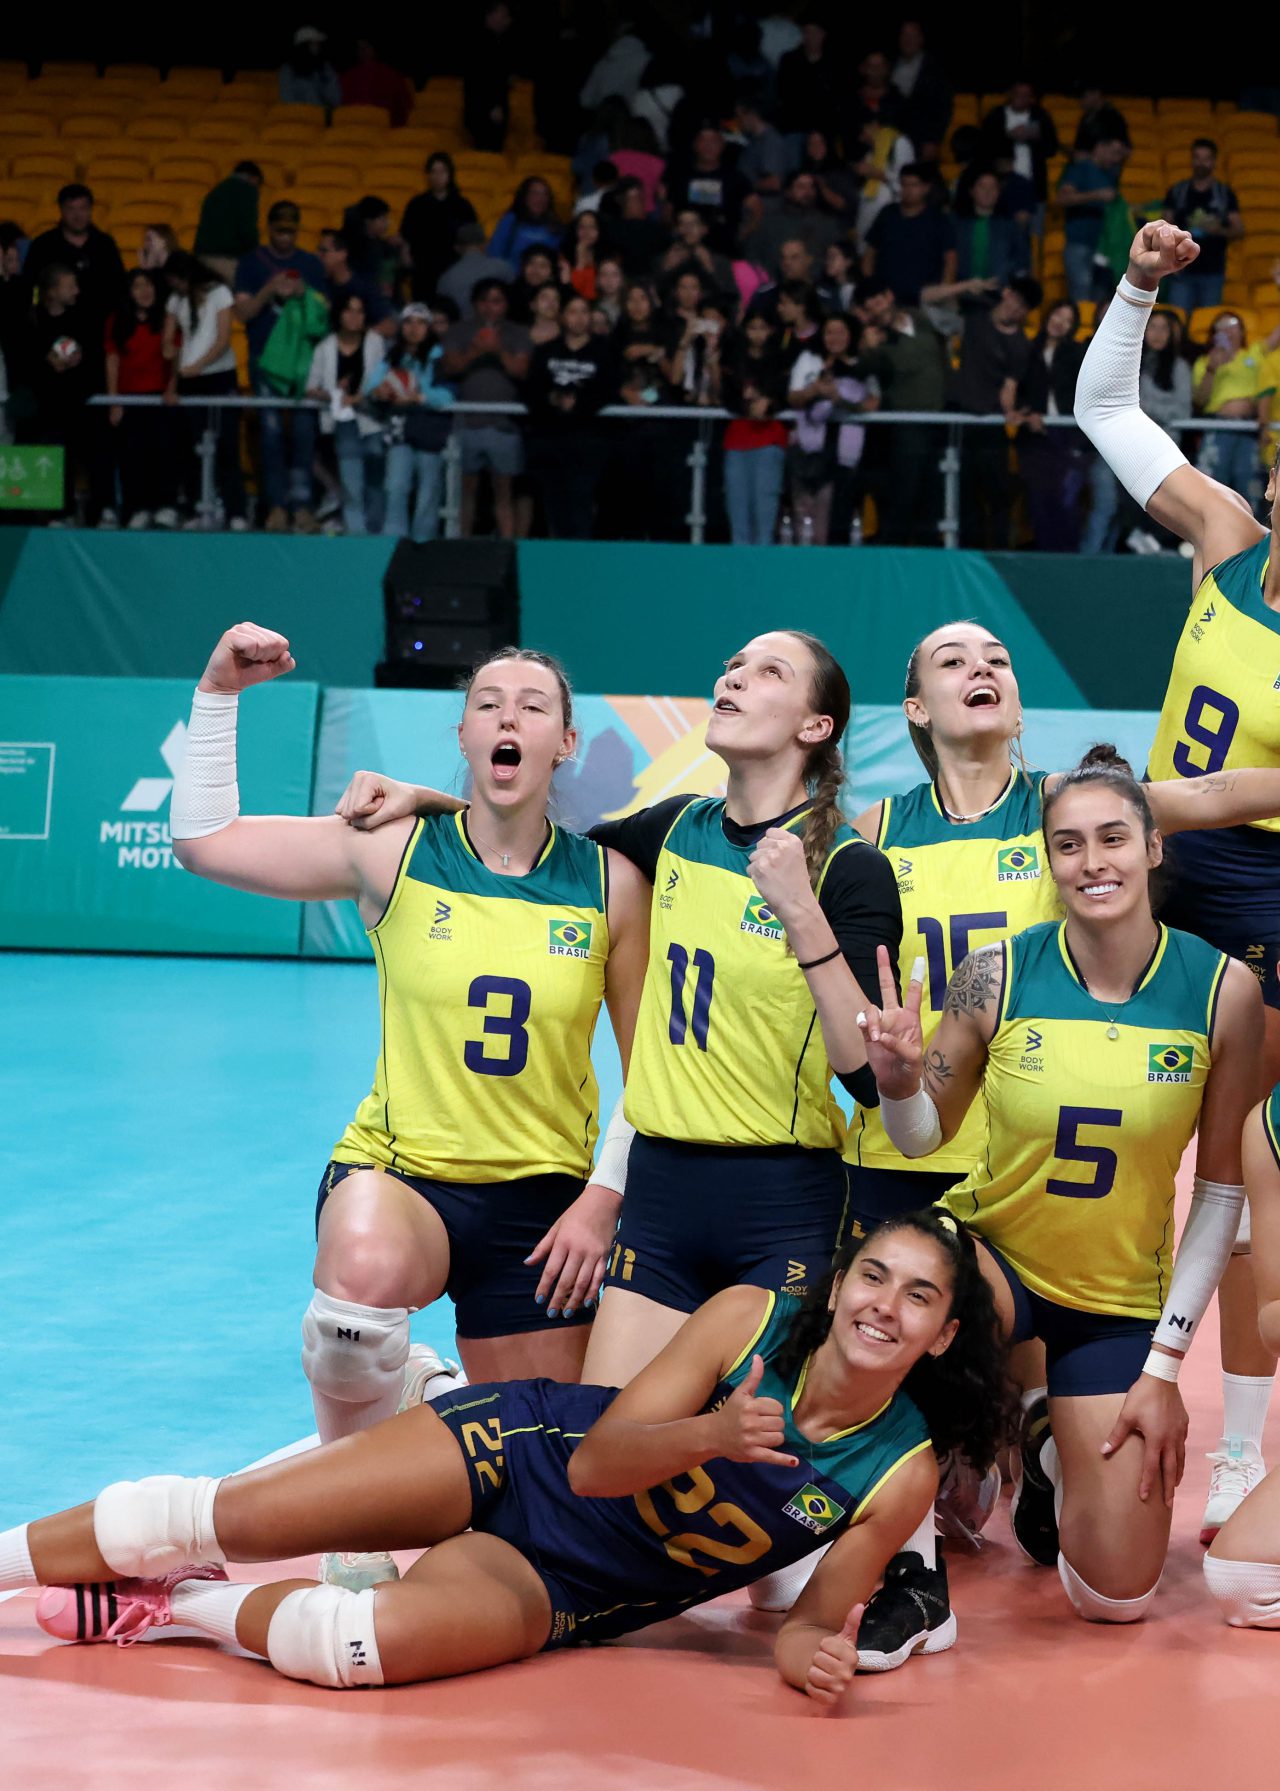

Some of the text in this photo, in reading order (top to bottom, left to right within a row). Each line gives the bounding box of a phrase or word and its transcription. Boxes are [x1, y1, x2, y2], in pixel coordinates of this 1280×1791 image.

[1173, 684, 1240, 778] 9
[998, 870, 1041, 882] BRASIL
[428, 933, 453, 942] WORK
[431, 926, 453, 935] BODY
[740, 921, 782, 940] BRASIL
[549, 945, 589, 959] BRASIL
[1243, 961, 1266, 976] ODY
[666, 942, 715, 1053] 11
[463, 974, 532, 1077] 3
[1018, 1063, 1045, 1073] WORK
[1020, 1056, 1045, 1065] BODY
[1147, 1072, 1190, 1083] BRASIL
[1046, 1105, 1123, 1199] 5
[610, 1242, 635, 1281] 11
[1168, 1312, 1193, 1333] N1
[337, 1326, 361, 1342] N1
[784, 1504, 825, 1532] BRASI
